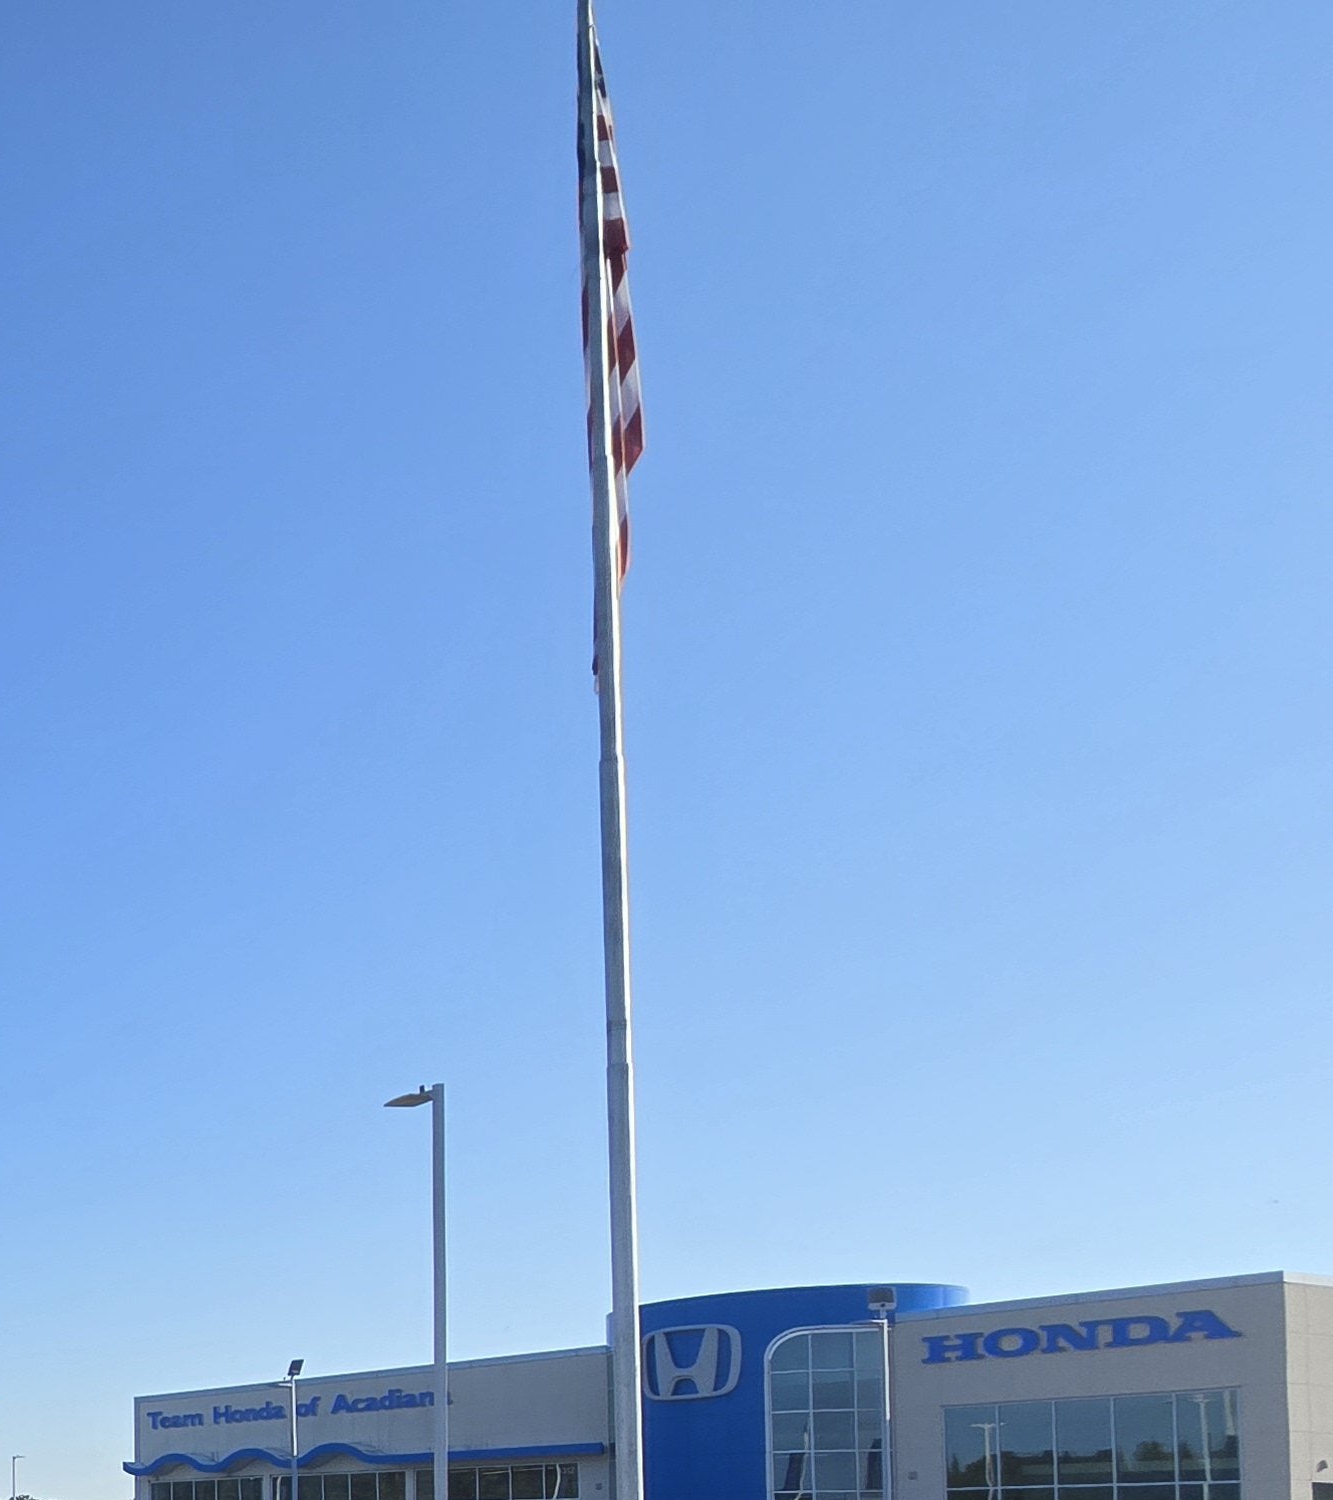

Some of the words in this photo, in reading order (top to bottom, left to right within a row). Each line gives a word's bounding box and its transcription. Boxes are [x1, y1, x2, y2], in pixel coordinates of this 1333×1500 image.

[921, 1309, 1244, 1365] HONDA
[146, 1410, 204, 1430] Team
[212, 1401, 287, 1425] Honda
[296, 1396, 322, 1418] of
